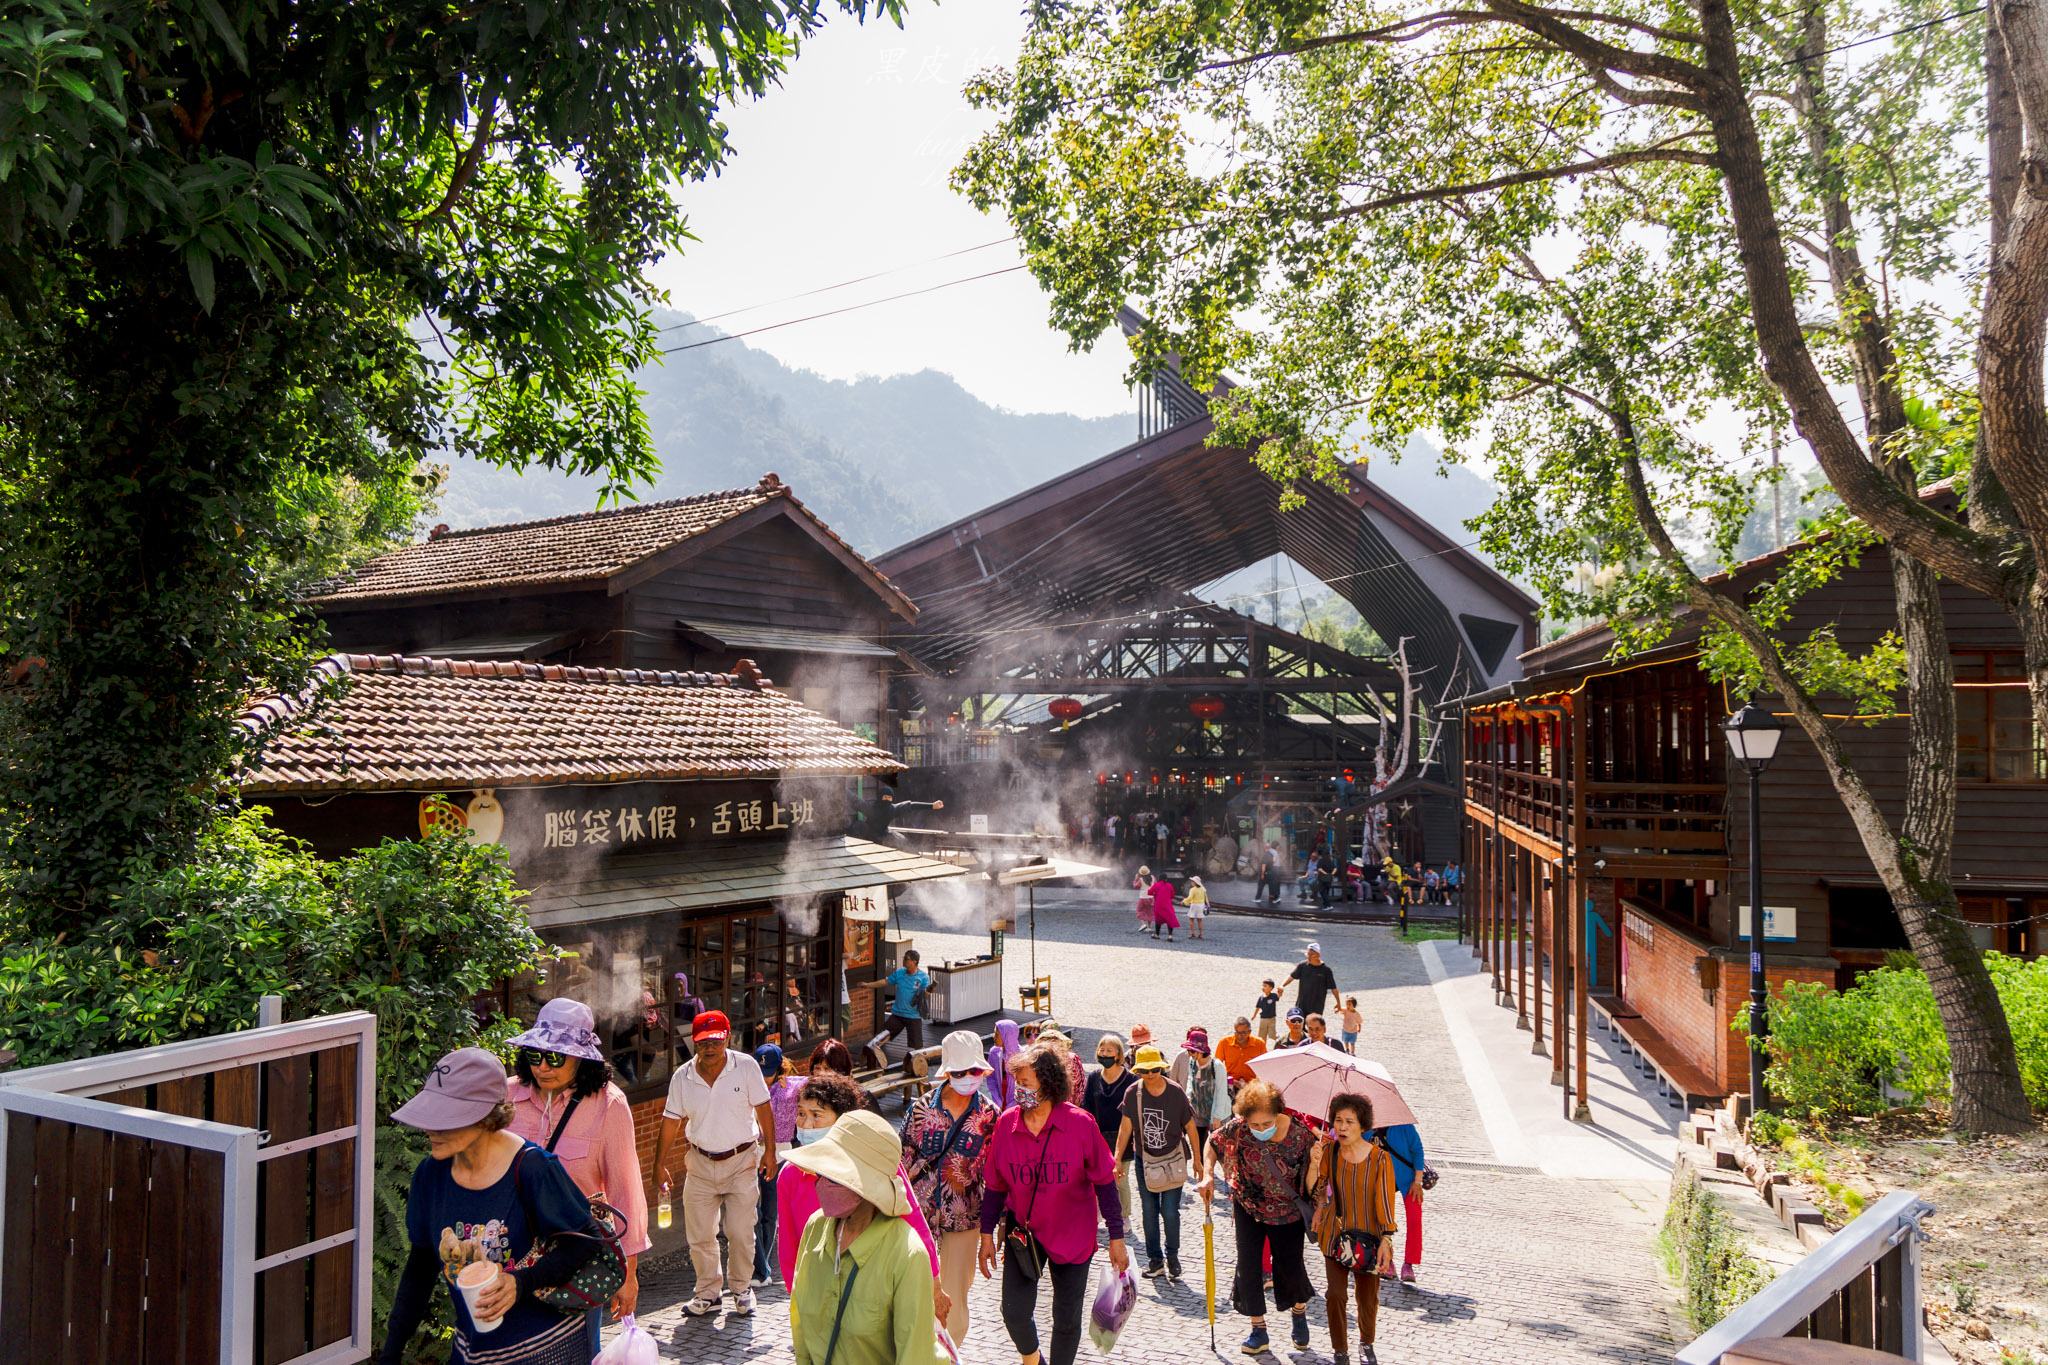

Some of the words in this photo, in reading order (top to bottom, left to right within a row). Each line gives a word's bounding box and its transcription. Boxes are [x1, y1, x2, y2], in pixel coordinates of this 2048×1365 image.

[543, 797, 815, 848] 腦袋休假，舌頭上班
[860, 924, 869, 934] 80
[1008, 1161, 1069, 1185] VOGUE
